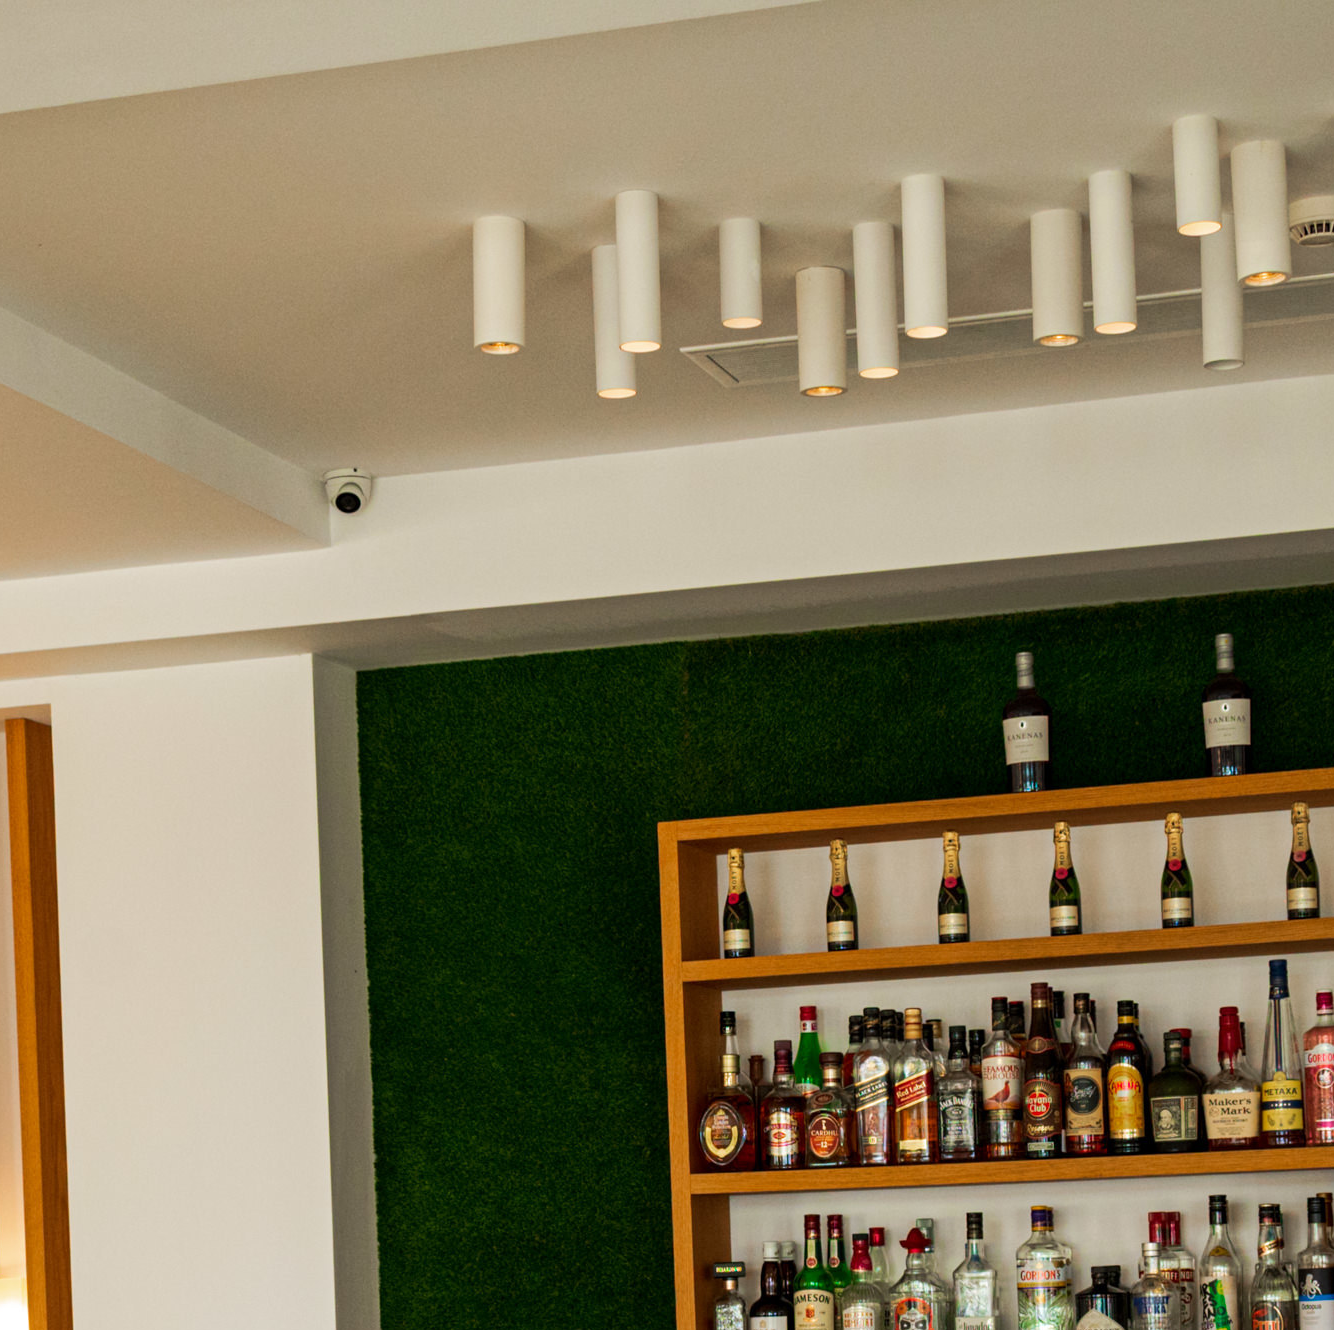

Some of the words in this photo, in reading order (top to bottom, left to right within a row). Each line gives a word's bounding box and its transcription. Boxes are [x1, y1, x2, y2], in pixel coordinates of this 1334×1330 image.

[1208, 714, 1246, 724] KANENAS
[1007, 731, 1043, 741] KANENAS
[987, 1065, 1020, 1073] FAMOUS
[986, 1073, 1020, 1081] GROUSE
[897, 1087, 910, 1098] Red
[910, 1080, 926, 1094] Label
[1264, 1087, 1298, 1096] METAXA
[1208, 1098, 1252, 1106] Maker's
[1029, 1104, 1047, 1113] Club
[1221, 1107, 1252, 1115] Mark
[1020, 1270, 1061, 1281] GORDON'S
[794, 1293, 830, 1305] JAMESON
